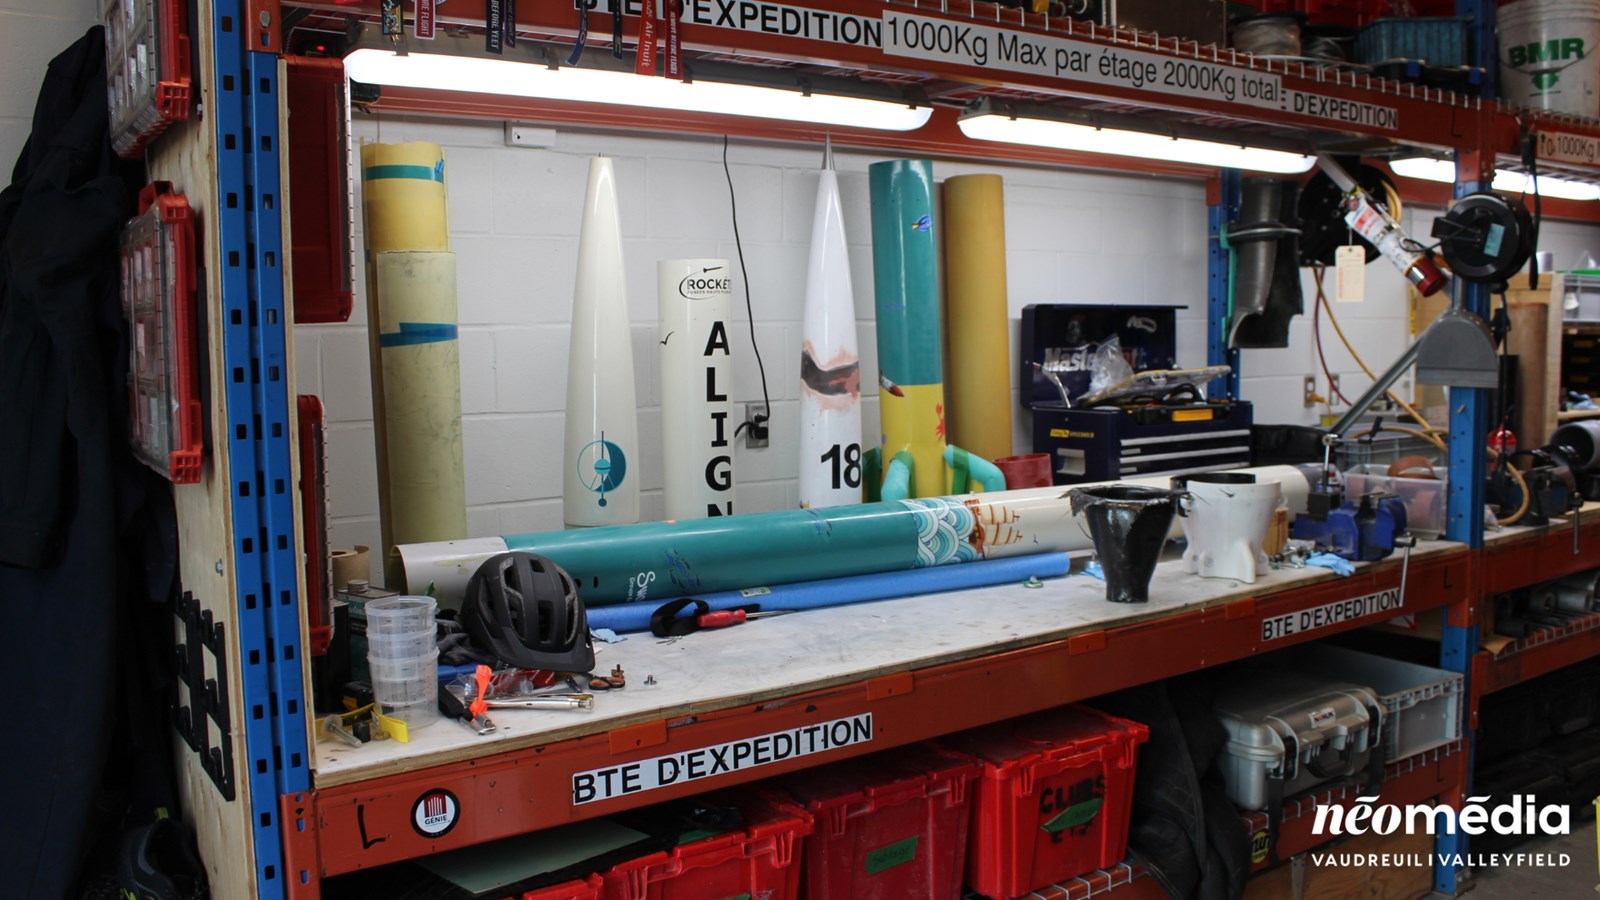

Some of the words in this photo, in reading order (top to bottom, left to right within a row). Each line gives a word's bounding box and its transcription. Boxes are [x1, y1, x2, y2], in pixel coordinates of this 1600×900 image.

[420, 12, 430, 35] FLIGHT
[491, 0, 499, 29] BEFORE
[645, 21, 653, 37] Air
[663, 0, 883, 48] 'EXPEDITION
[491, 30, 499, 49] YEET
[641, 41, 653, 67] Inuit
[1508, 38, 1584, 68] BMR
[887, 16, 988, 66] 1000Kg
[998, 32, 1047, 67] Max
[1055, 47, 1094, 76] par
[1100, 48, 1157, 87] étage
[1163, 60, 1236, 101] 2000Kg
[1242, 73, 1279, 102] total
[1294, 92, 1397, 128] D'EXPEDITION
[821, 443, 861, 490] 18
[1263, 615, 1294, 641] BTE
[1300, 589, 1400, 630] D'EXPEDITION
[573, 763, 641, 804] BTE
[658, 713, 872, 785] D'EXPEDITION
[425, 815, 448, 825] GÉNIE
